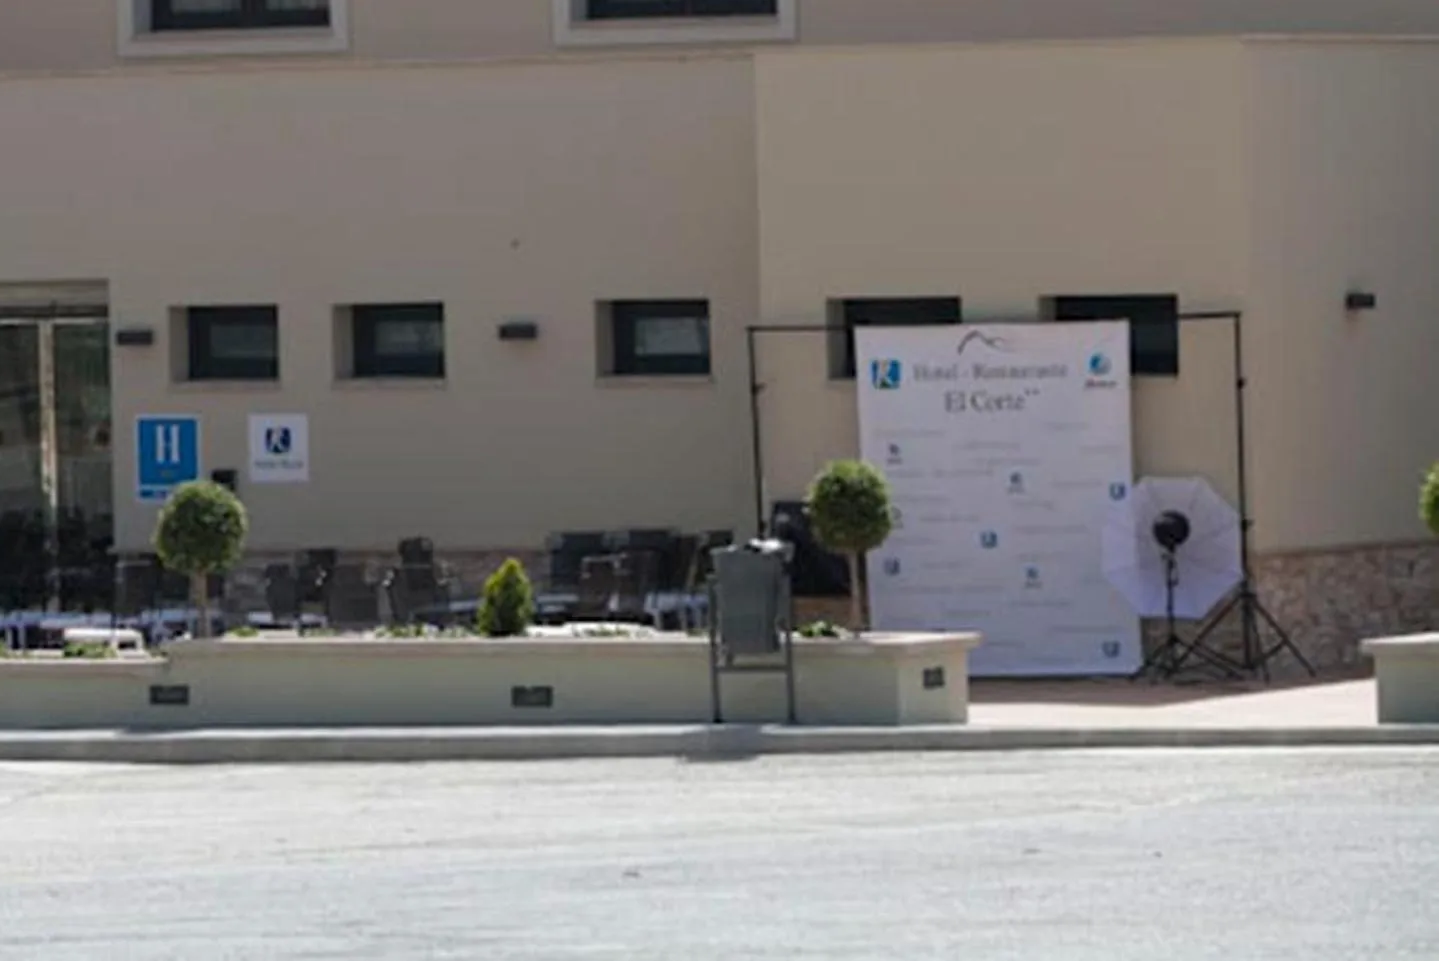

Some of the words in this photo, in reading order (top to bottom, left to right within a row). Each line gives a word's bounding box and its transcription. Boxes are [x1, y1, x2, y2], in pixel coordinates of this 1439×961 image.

[913, 363, 958, 382] Hotel
[972, 361, 1068, 381] Restaurante
[944, 393, 966, 413] El
[156, 425, 180, 464] H
